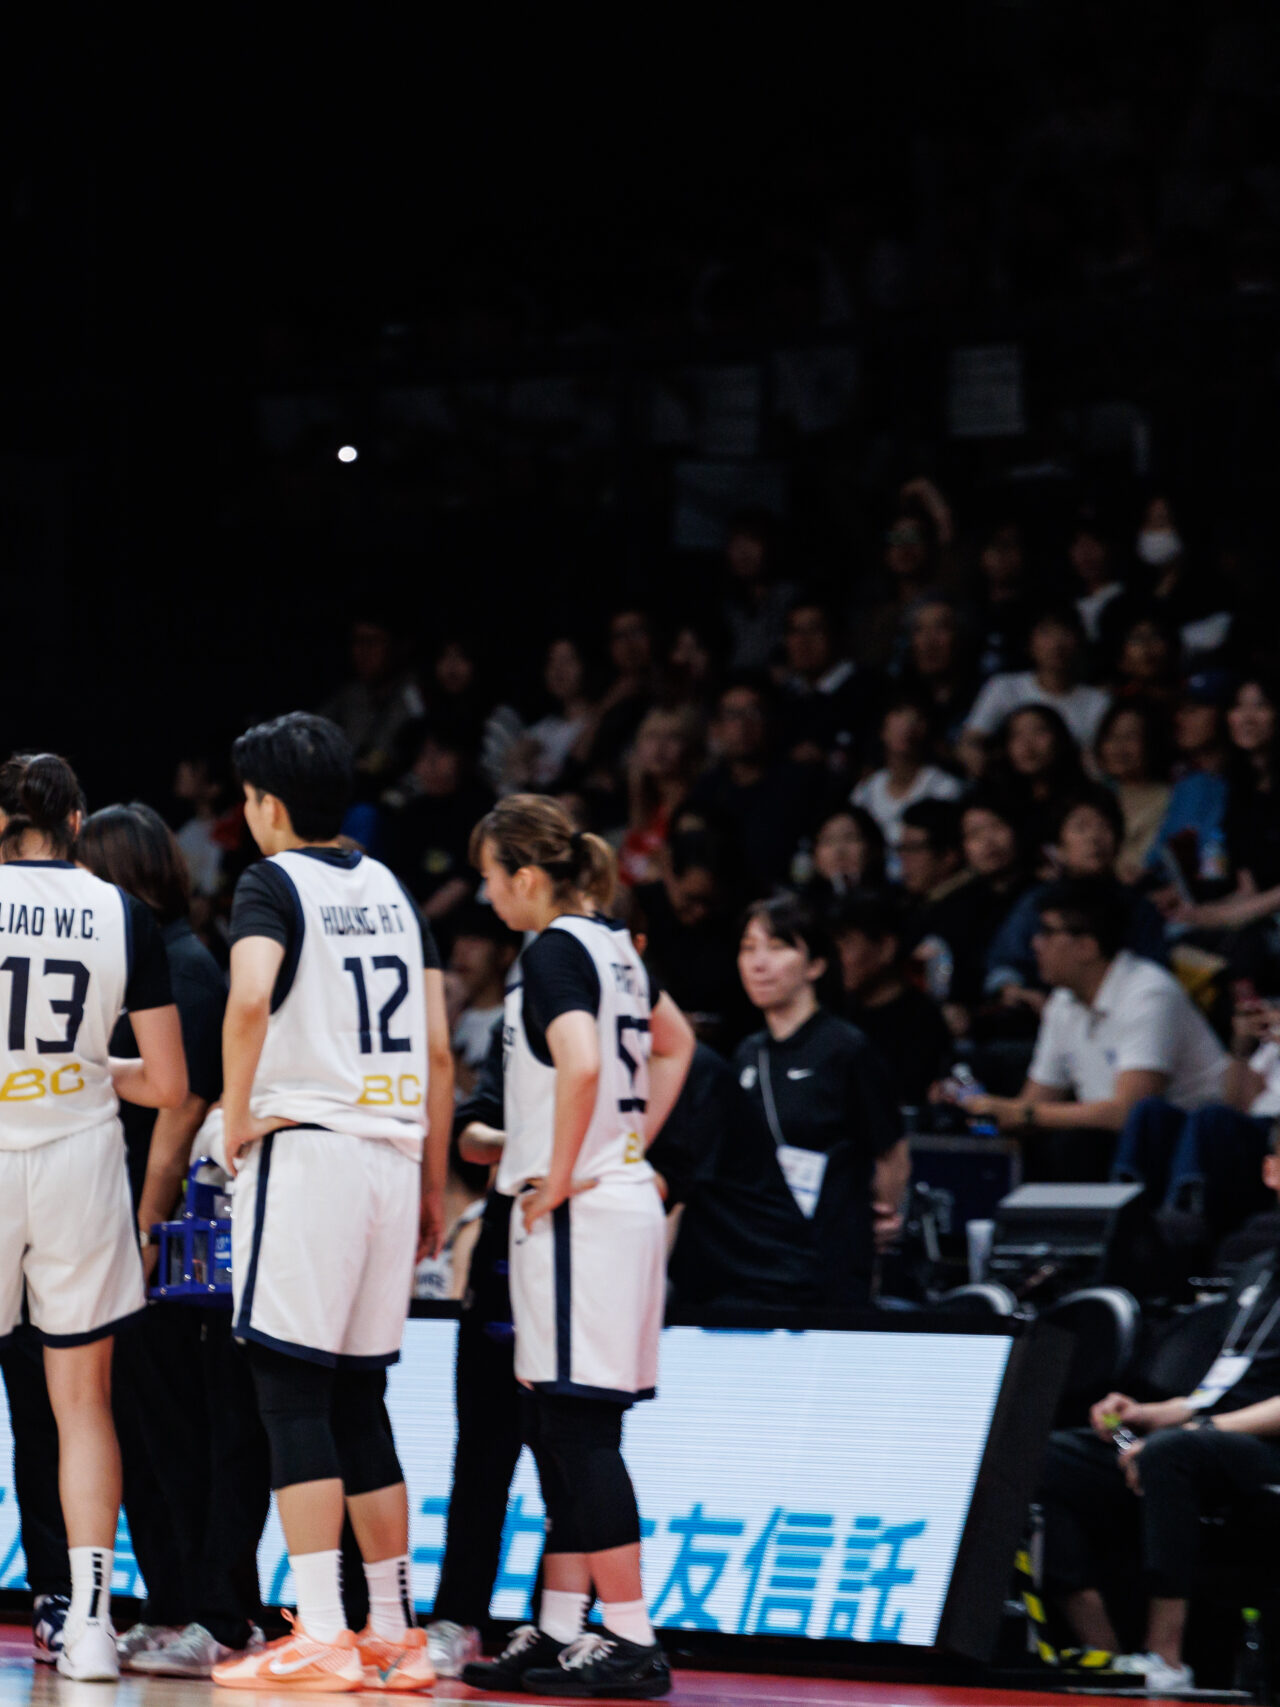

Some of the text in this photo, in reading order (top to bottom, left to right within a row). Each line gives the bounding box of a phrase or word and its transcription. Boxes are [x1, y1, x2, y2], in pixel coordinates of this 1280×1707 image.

[54, 906, 100, 941] W.C.
[344, 955, 412, 1055] 12
[357, 1074, 422, 1106] BC
